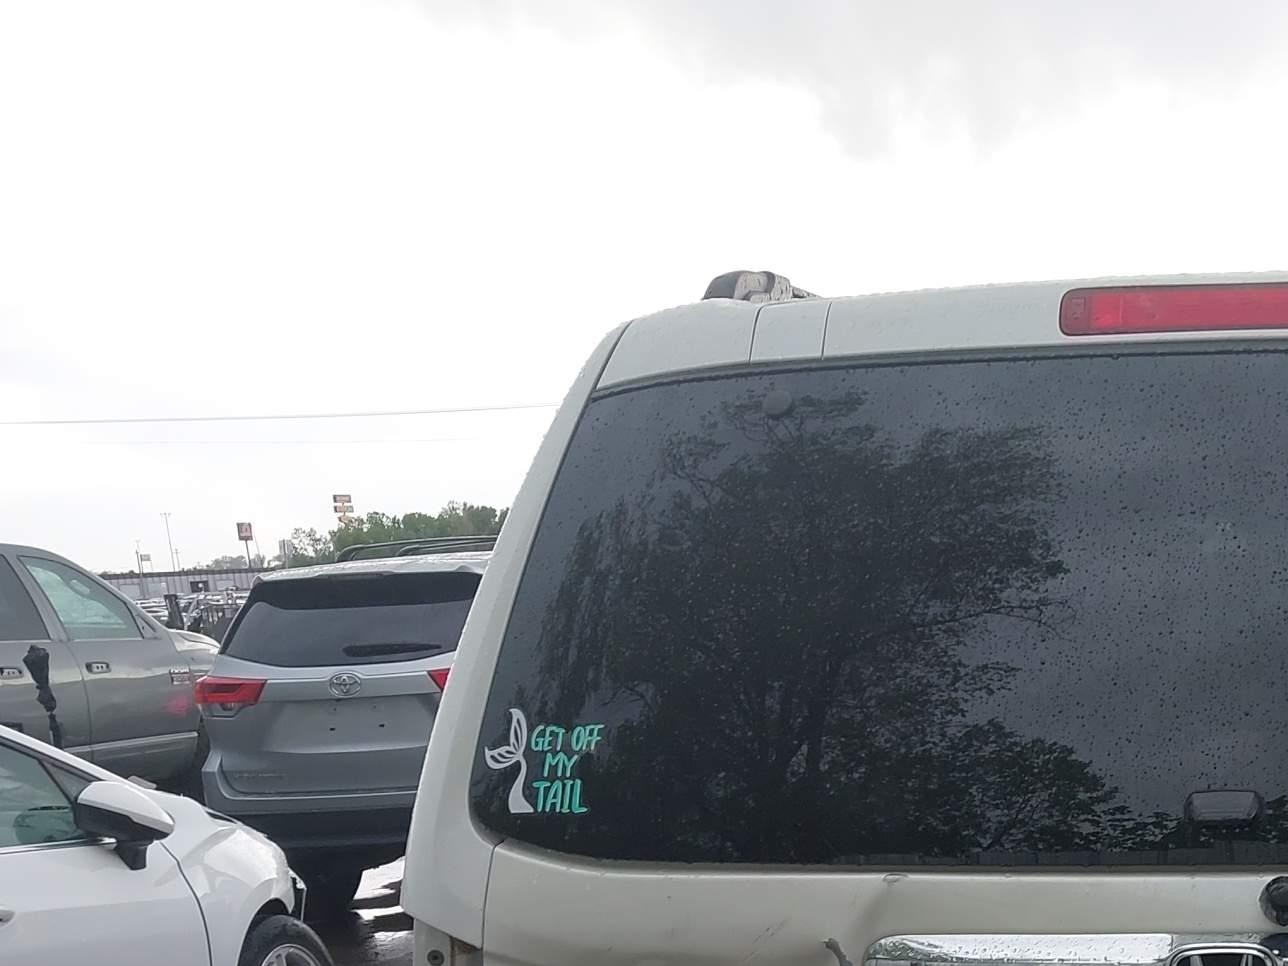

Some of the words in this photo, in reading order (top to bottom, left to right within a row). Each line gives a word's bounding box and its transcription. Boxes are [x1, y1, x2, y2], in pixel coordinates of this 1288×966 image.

[531, 725, 565, 751] GET
[571, 724, 604, 751] OFF
[543, 752, 578, 777] MY
[532, 779, 588, 813] TAIL
